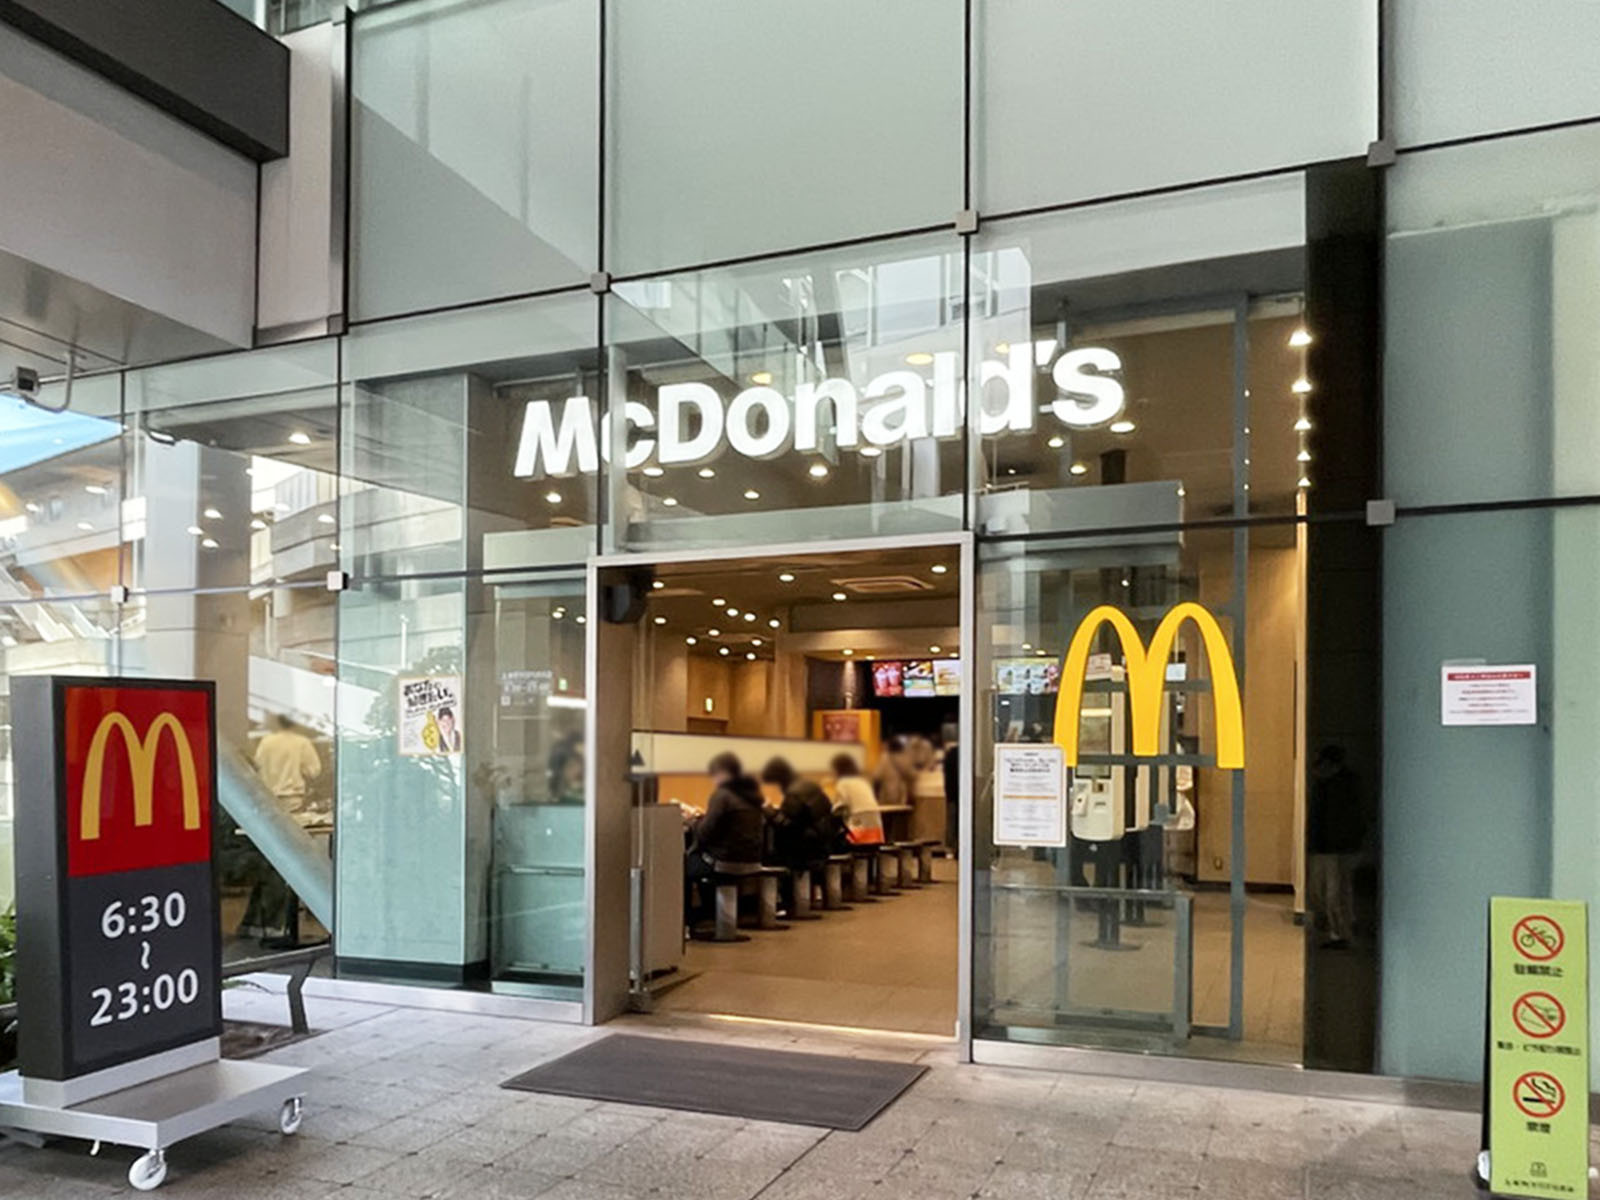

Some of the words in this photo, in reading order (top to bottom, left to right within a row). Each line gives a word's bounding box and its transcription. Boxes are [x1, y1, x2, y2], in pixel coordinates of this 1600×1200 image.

[513, 339, 1126, 478] McDonald's
[101, 891, 187, 939] 6:30
[89, 967, 200, 1027] 23:00
